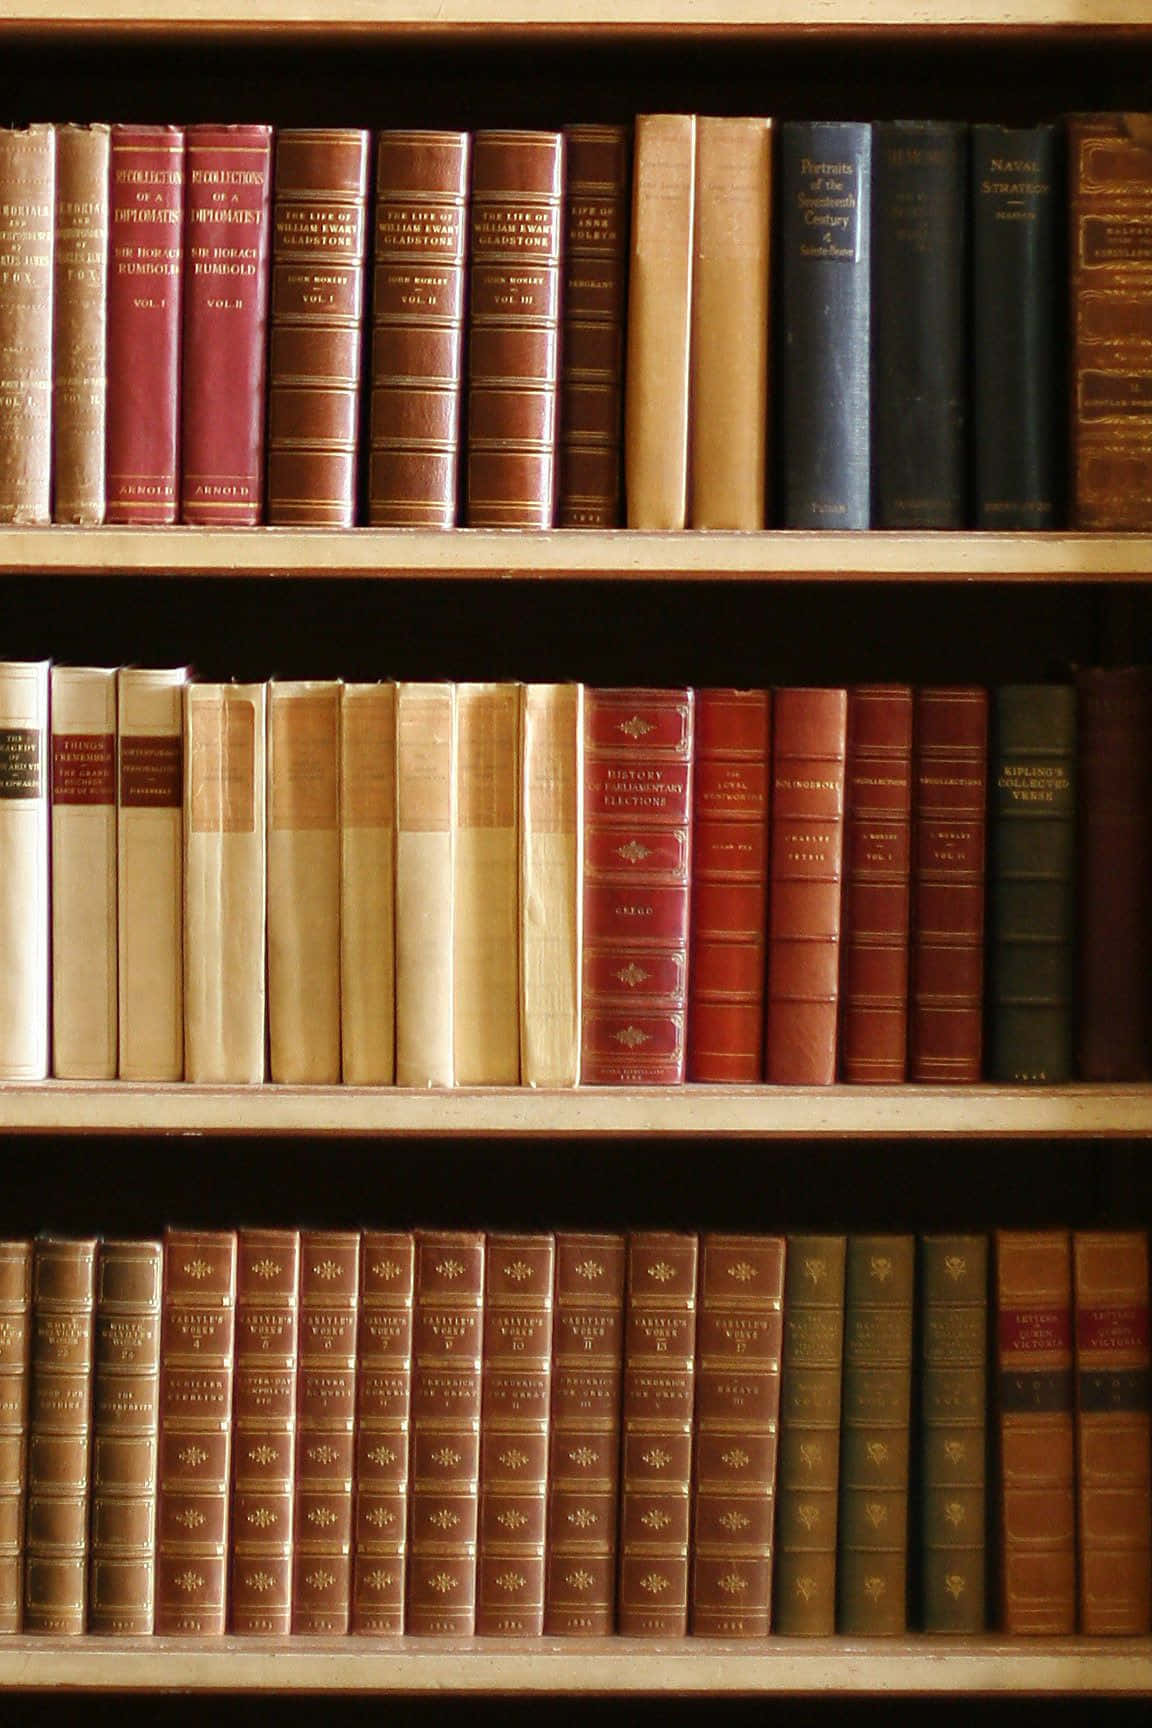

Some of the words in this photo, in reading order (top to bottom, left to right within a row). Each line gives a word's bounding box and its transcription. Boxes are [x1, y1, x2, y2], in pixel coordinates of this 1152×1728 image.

[799, 158, 854, 177] Portraits
[990, 159, 1040, 173] NAVAL
[192, 169, 264, 185] RECOLLECTIONS
[809, 177, 822, 191] of
[825, 177, 844, 192] the
[136, 193, 149, 202] OF
[155, 193, 163, 202] A
[212, 193, 226, 202] OF
[231, 193, 240, 202] A
[796, 194, 857, 210] Seventeenth
[191, 208, 261, 224] DIPLOMATIST
[309, 212, 336, 222] LIFE
[337, 212, 352, 222] OF
[410, 212, 437, 222] LIFE
[439, 212, 454, 222] OF
[505, 212, 533, 222] LIFE
[534, 212, 549, 222] OF
[803, 209, 850, 230] Century
[283, 236, 353, 247] GLADSTONE
[383, 236, 454, 247] GLADSTONE
[478, 236, 549, 247] GLADSTONE
[191, 248, 210, 258] SIR
[214, 248, 257, 259] HORACE
[118, 263, 180, 276] RUMBOLD
[195, 263, 257, 276] RUMBOLD
[119, 485, 175, 496] ARNOLD
[195, 485, 249, 496] ARNOLD
[6, 735, 24, 743] THE
[63, 741, 105, 751] THINGS
[8, 753, 20, 762] OF
[607, 770, 665, 781] HISTORY
[1003, 767, 1064, 778] KIPLING'S
[603, 782, 684, 795] PARLIAMENTARY
[997, 778, 1070, 789] COLLECTED
[1012, 790, 1054, 801] VERSE
[603, 796, 667, 808] ELECTIONS
[644, 1328, 679, 1338] WORKS
[511, 1341, 525, 1351] 10
[1013, 1339, 1064, 1350] VICTORIA
[1090, 1337, 1144, 1348] VICTORIA
